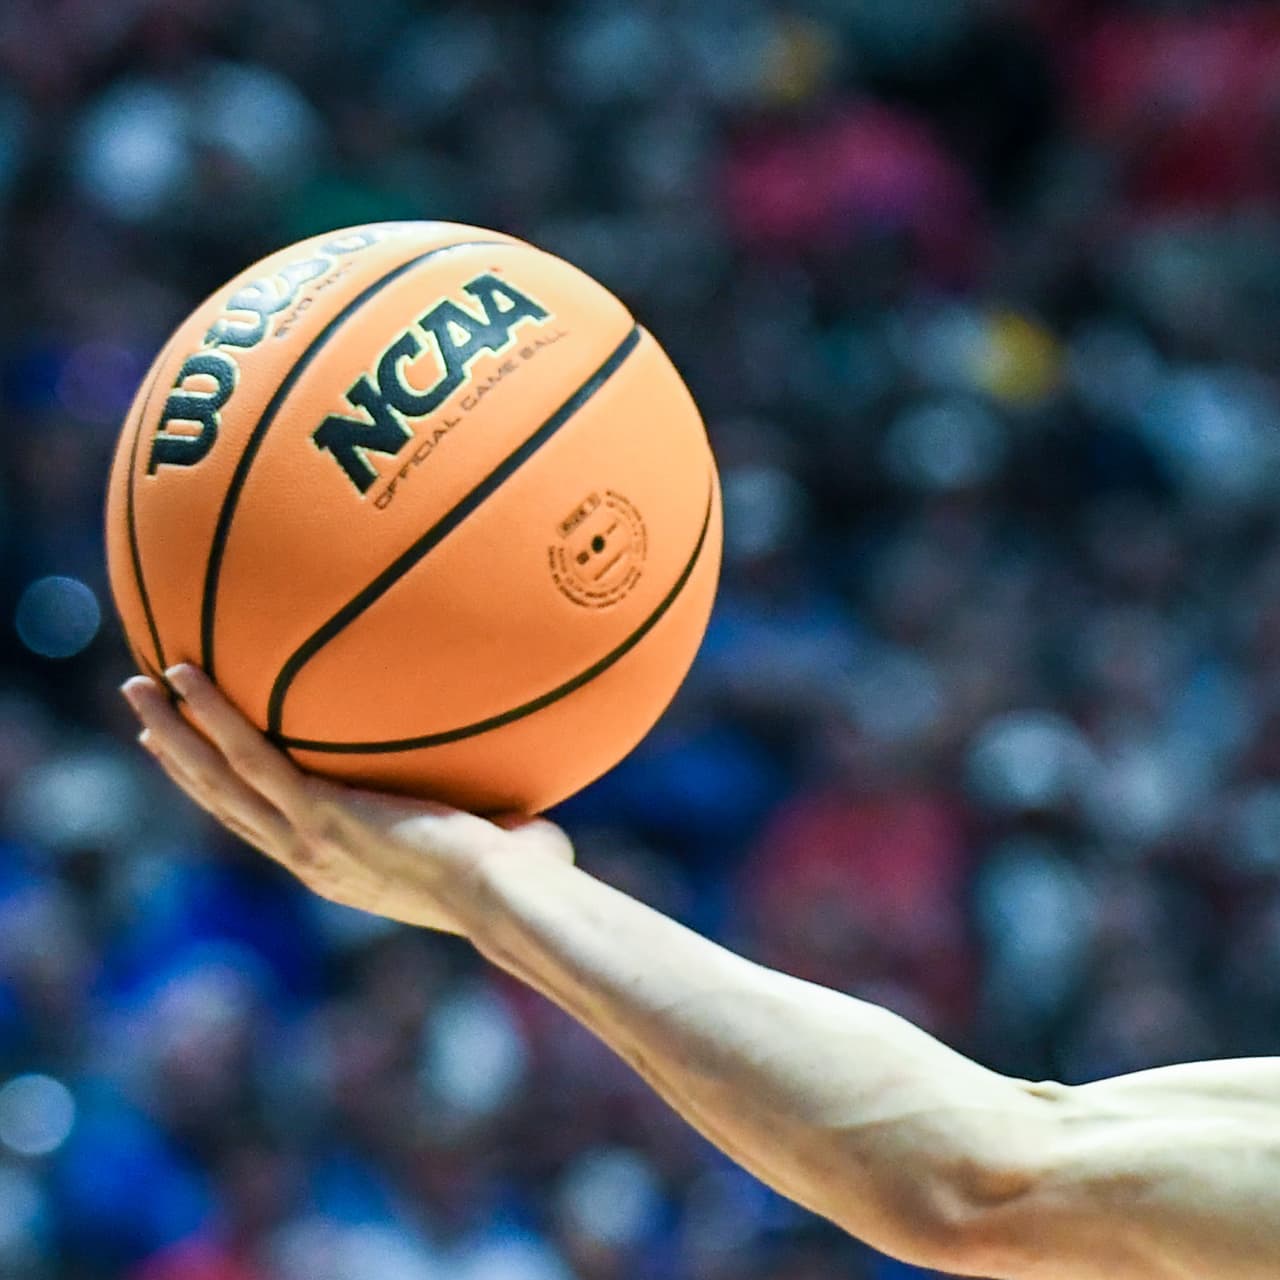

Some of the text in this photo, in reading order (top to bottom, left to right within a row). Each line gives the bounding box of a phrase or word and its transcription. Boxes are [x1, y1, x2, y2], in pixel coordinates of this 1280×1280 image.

[145, 227, 402, 477] Wilso
[312, 273, 553, 496] NCAA
[373, 330, 568, 510] OFFICIAL GAME BALL
